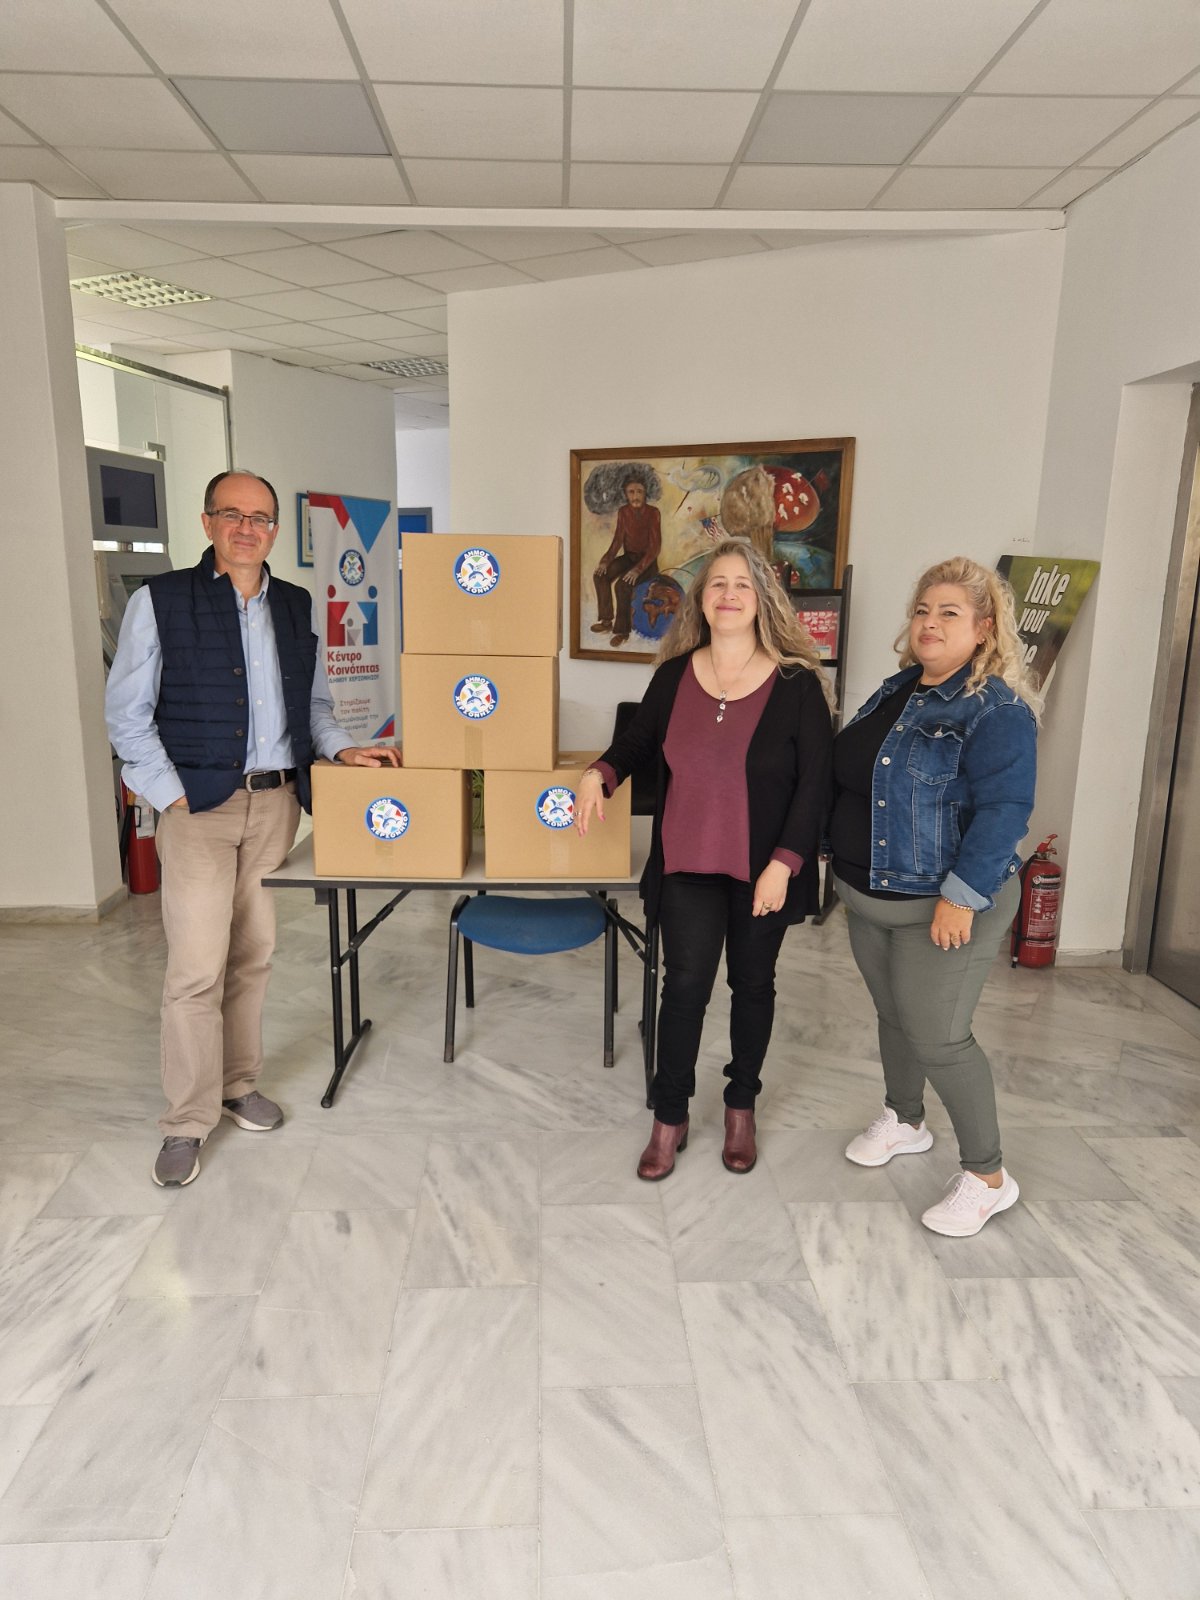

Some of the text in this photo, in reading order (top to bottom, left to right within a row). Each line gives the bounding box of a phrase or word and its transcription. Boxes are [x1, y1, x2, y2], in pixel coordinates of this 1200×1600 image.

[464, 550, 490, 560] ΔΗΜΟΣ
[1024, 564, 1071, 606] take
[1017, 607, 1051, 634] your
[327, 650, 362, 664] Κέντρο
[327, 663, 380, 677] Κοινότητας
